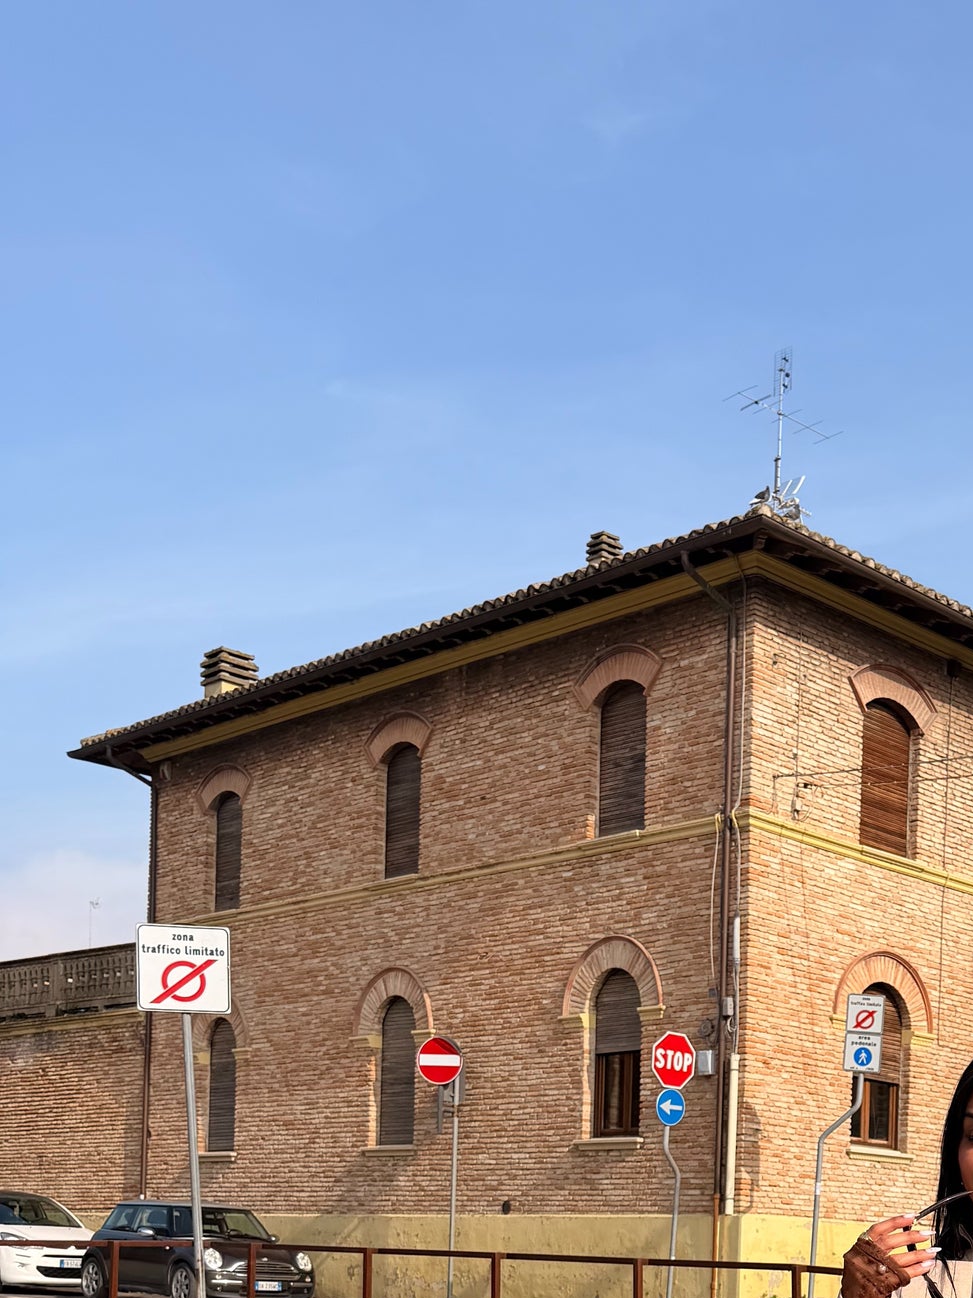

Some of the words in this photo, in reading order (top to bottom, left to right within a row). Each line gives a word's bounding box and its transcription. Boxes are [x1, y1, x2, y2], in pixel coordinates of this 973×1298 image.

[172, 933, 194, 942] zona
[142, 944, 181, 955] traffico
[185, 945, 225, 957] limitato
[655, 1048, 693, 1072] STOP
